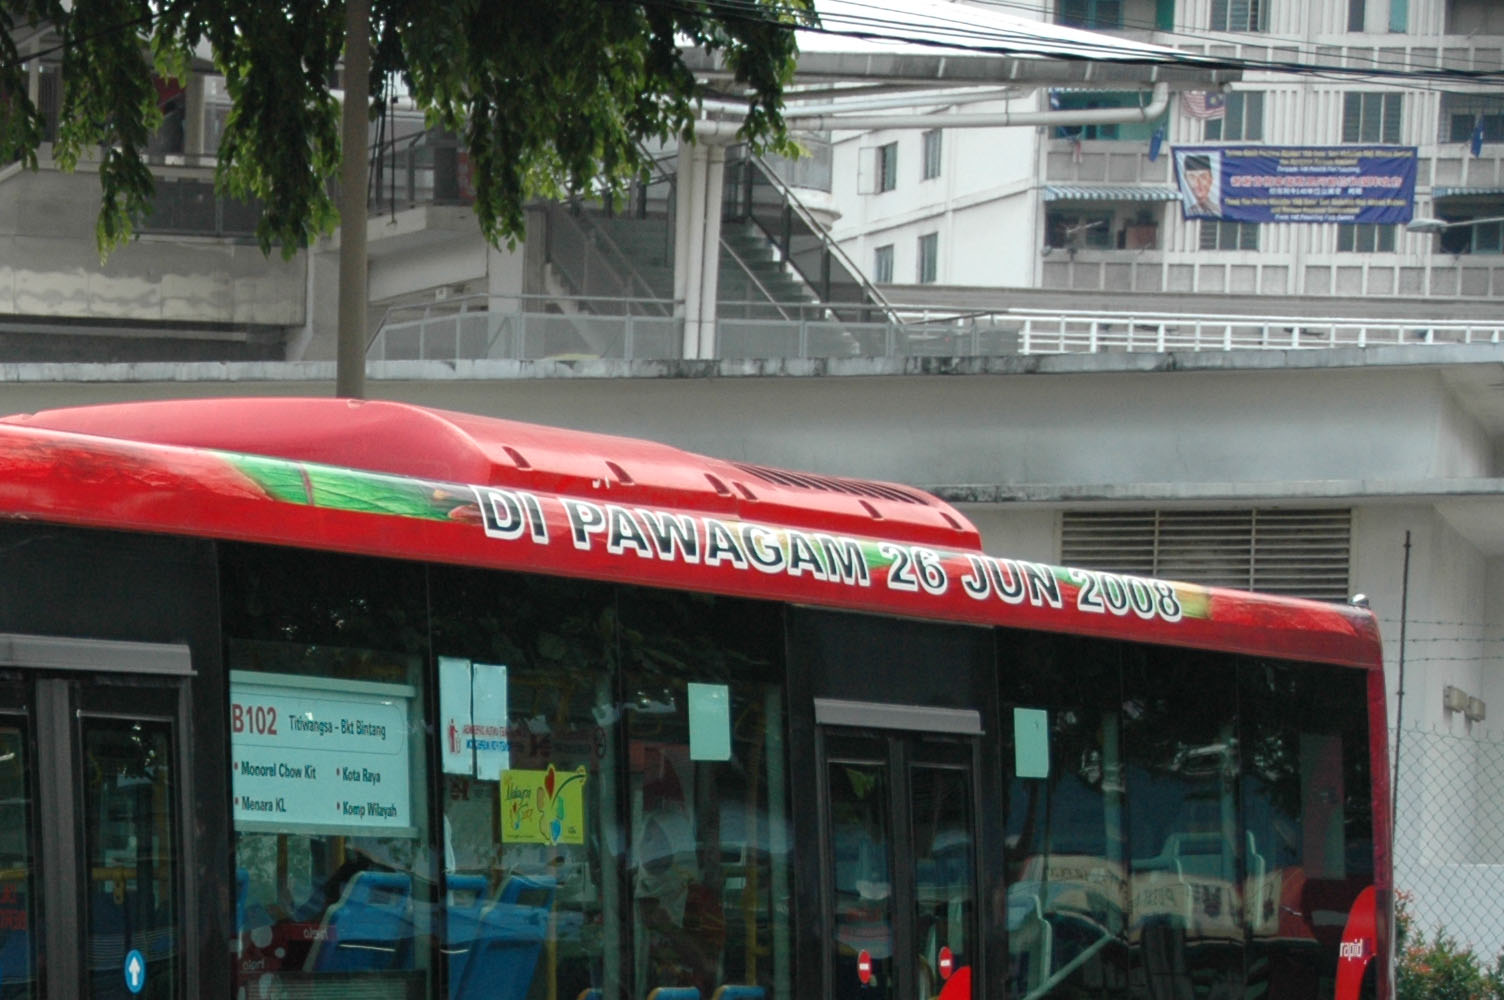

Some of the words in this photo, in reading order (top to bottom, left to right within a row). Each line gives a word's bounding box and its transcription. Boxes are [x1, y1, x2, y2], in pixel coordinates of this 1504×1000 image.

[469, 484, 549, 544] DI
[558, 497, 870, 586] PAWAGAM
[877, 542, 947, 595] 26
[962, 554, 1062, 609] JUN
[1067, 567, 1183, 622] 2008
[231, 704, 277, 735] B102
[356, 720, 386, 741] Bintang
[304, 764, 316, 780] Kit
[342, 767, 361, 782] Kota
[362, 768, 381, 786] Raya
[241, 796, 273, 812] Menara
[275, 798, 287, 813] KL
